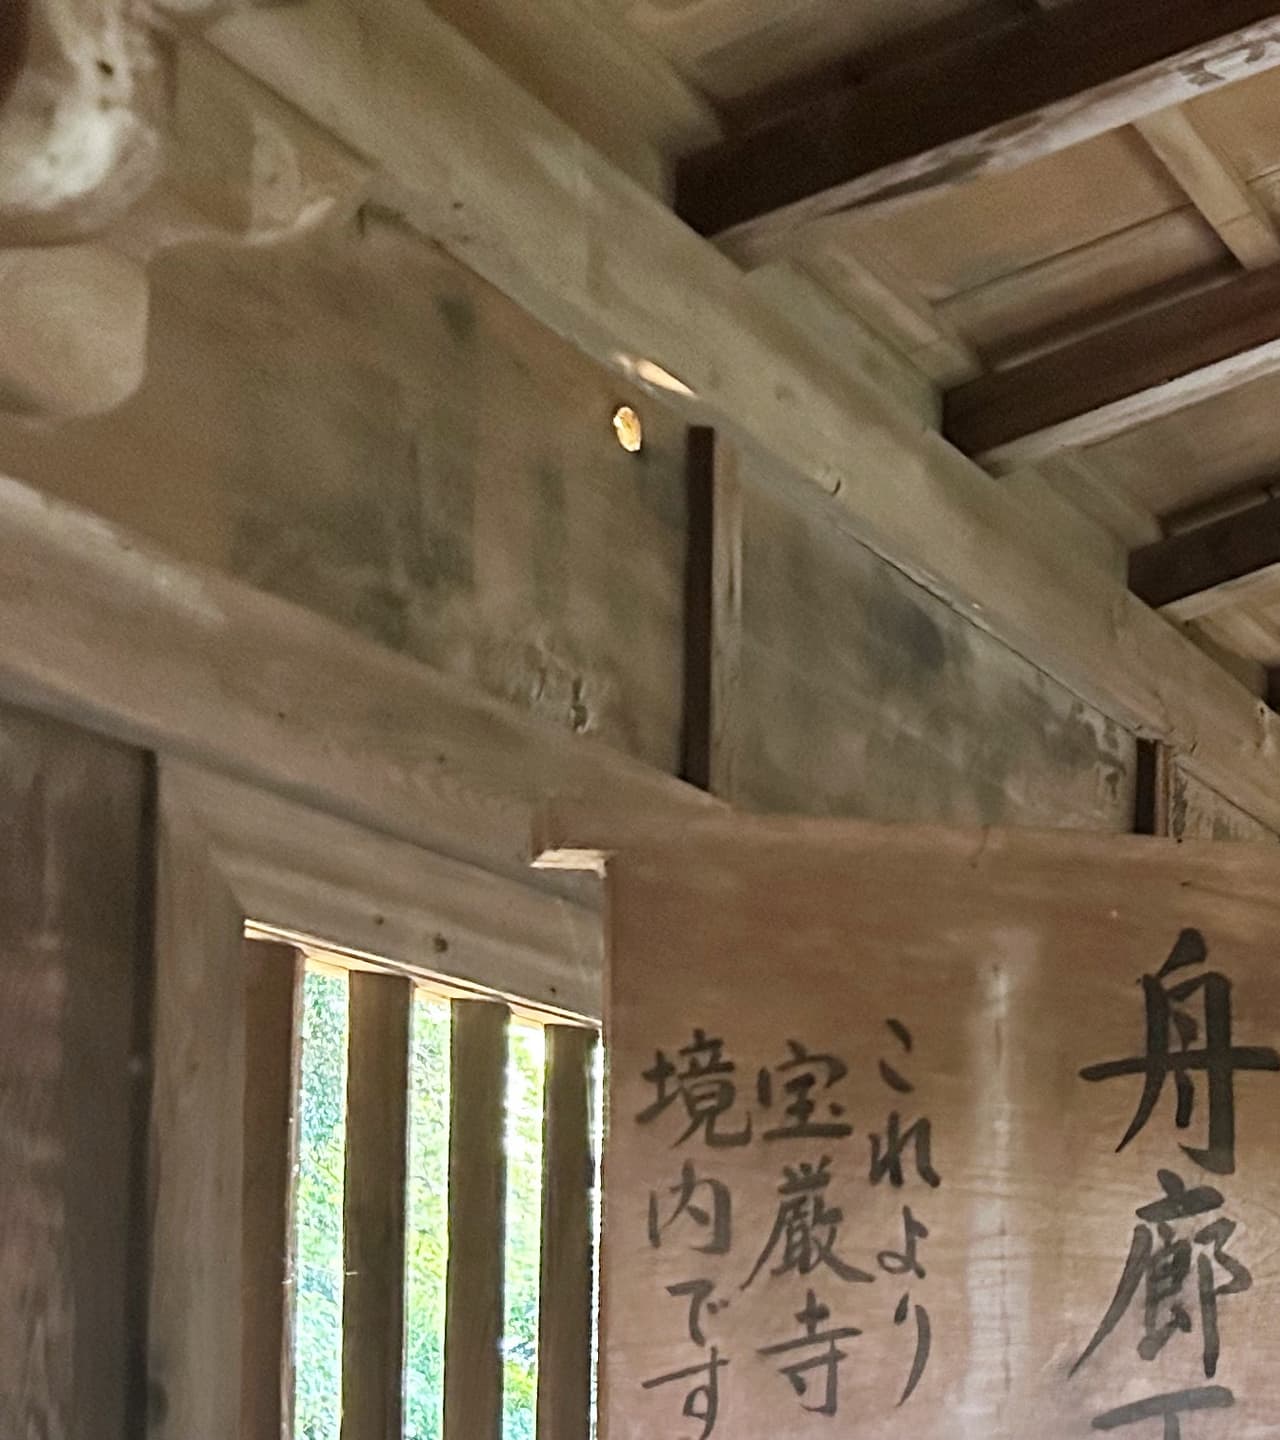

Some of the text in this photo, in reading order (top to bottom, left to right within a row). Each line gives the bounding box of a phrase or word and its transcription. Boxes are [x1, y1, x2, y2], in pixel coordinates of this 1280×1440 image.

[742, 1040, 874, 1417] 宝厳寺
[868, 1018, 942, 1407] これより
